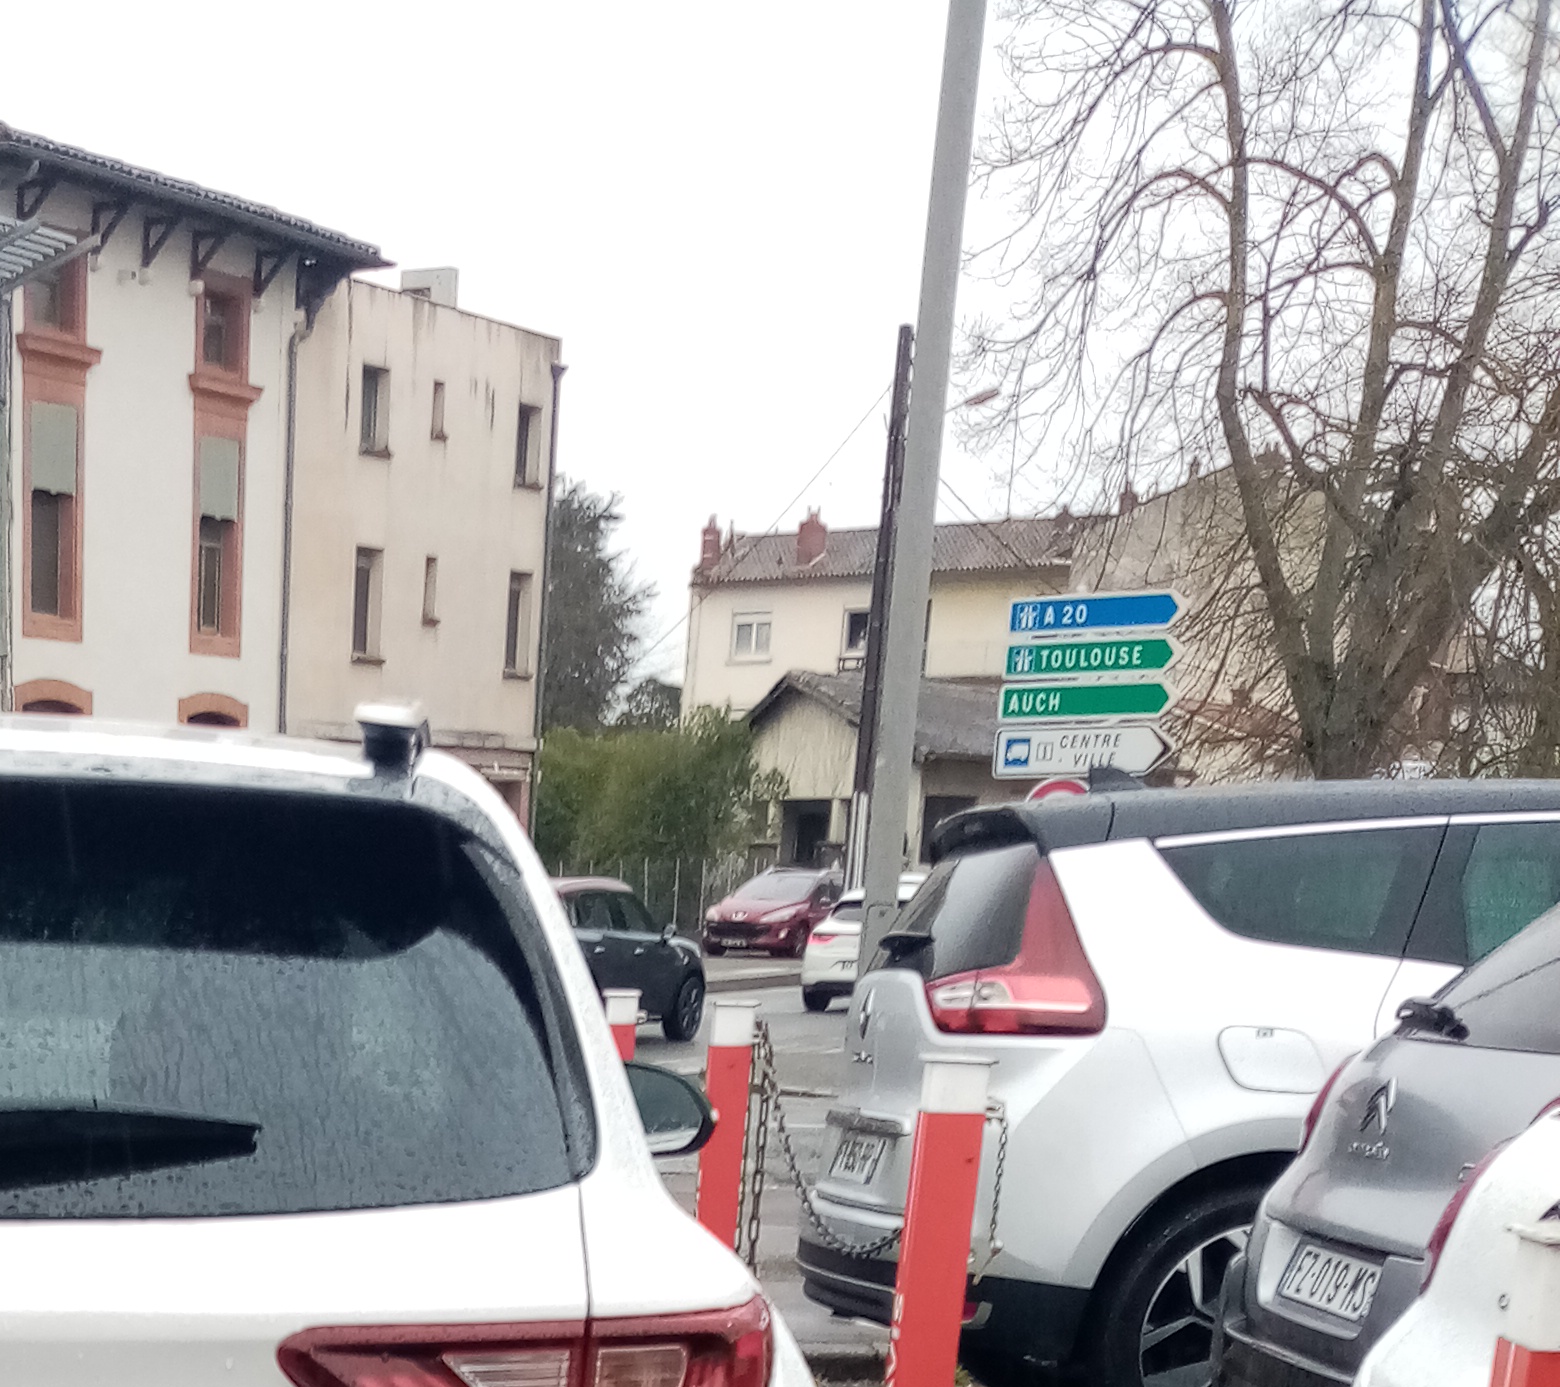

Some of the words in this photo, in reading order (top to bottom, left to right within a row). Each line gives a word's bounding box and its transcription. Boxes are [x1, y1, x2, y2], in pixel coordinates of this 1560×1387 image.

[1043, 605, 1056, 626] A
[1061, 603, 1089, 625] 20
[1040, 644, 1144, 670] TOULOUSE
[1007, 691, 1062, 714] AUCH
[1060, 733, 1123, 749] CENTRE
